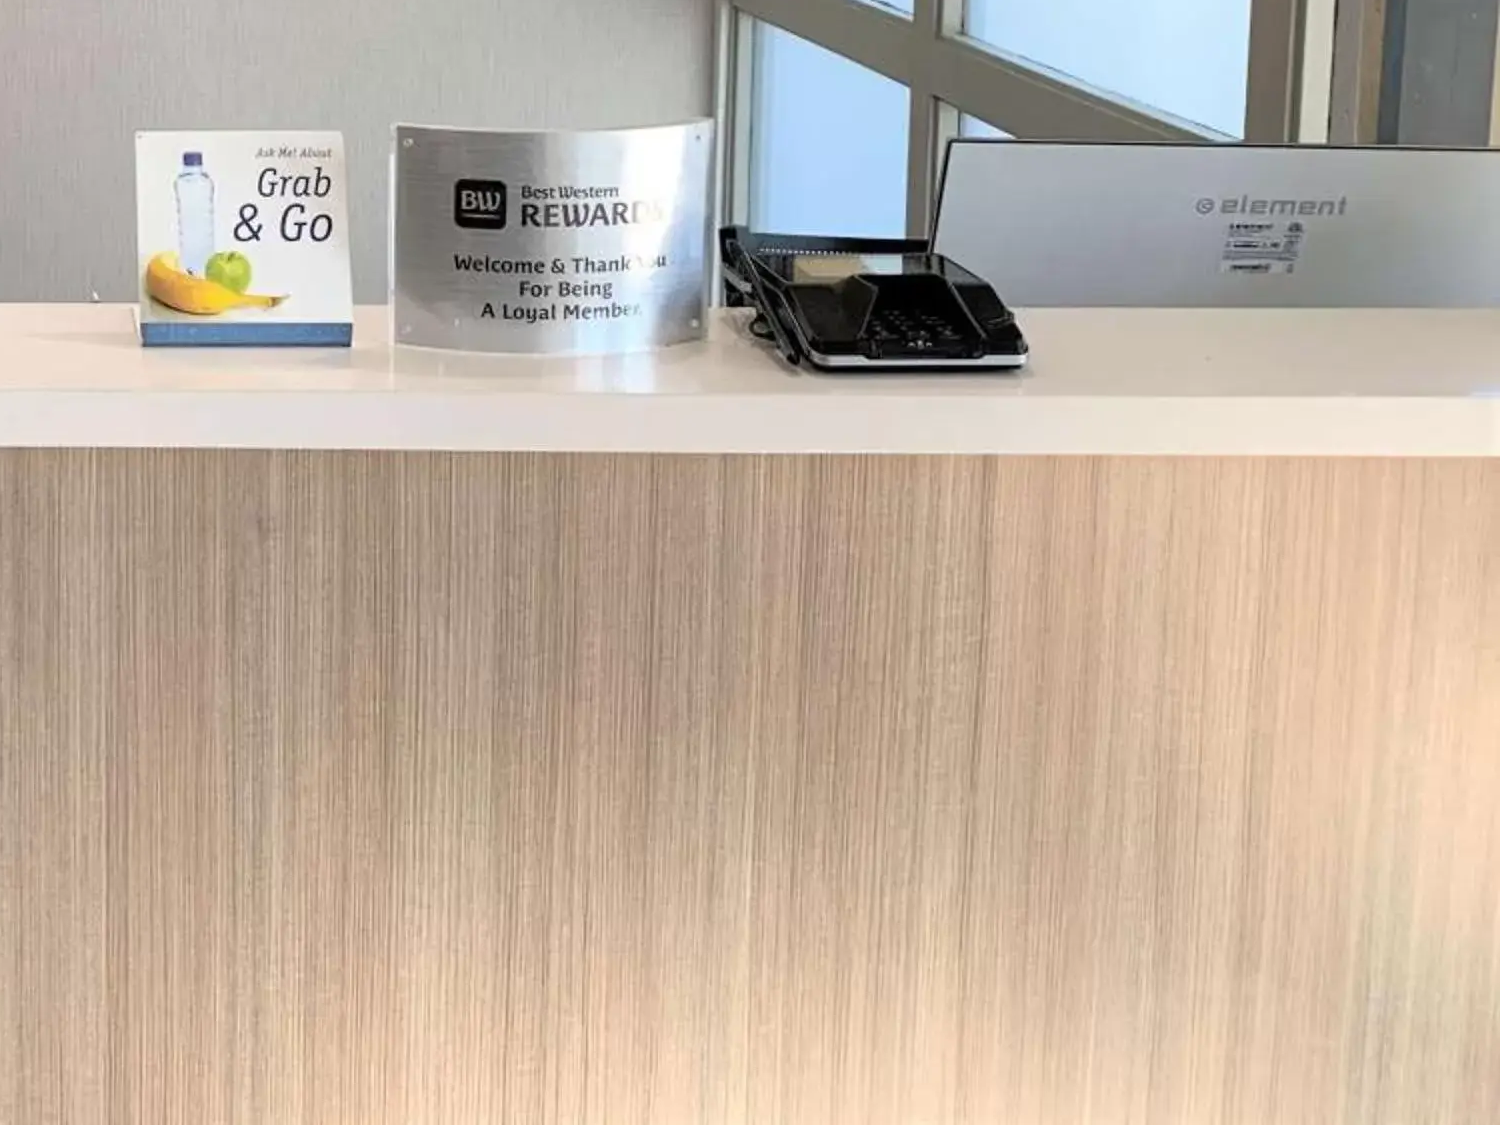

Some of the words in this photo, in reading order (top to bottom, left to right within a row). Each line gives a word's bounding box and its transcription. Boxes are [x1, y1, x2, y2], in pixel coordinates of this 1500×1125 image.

[255, 147, 275, 158] Ask
[299, 147, 332, 158] About
[257, 166, 332, 198] Grab
[521, 185, 555, 200] Best
[558, 185, 619, 200] Western
[460, 188, 501, 211] BW
[1220, 194, 1348, 216] element
[233, 203, 263, 242] &
[280, 203, 333, 242] Go
[453, 254, 546, 275] Welcome
[550, 257, 566, 275] &
[570, 255, 631, 274] Thank
[519, 280, 553, 298] For
[558, 280, 614, 299] Being
[481, 302, 496, 319] A
[502, 301, 556, 323] Loyal
